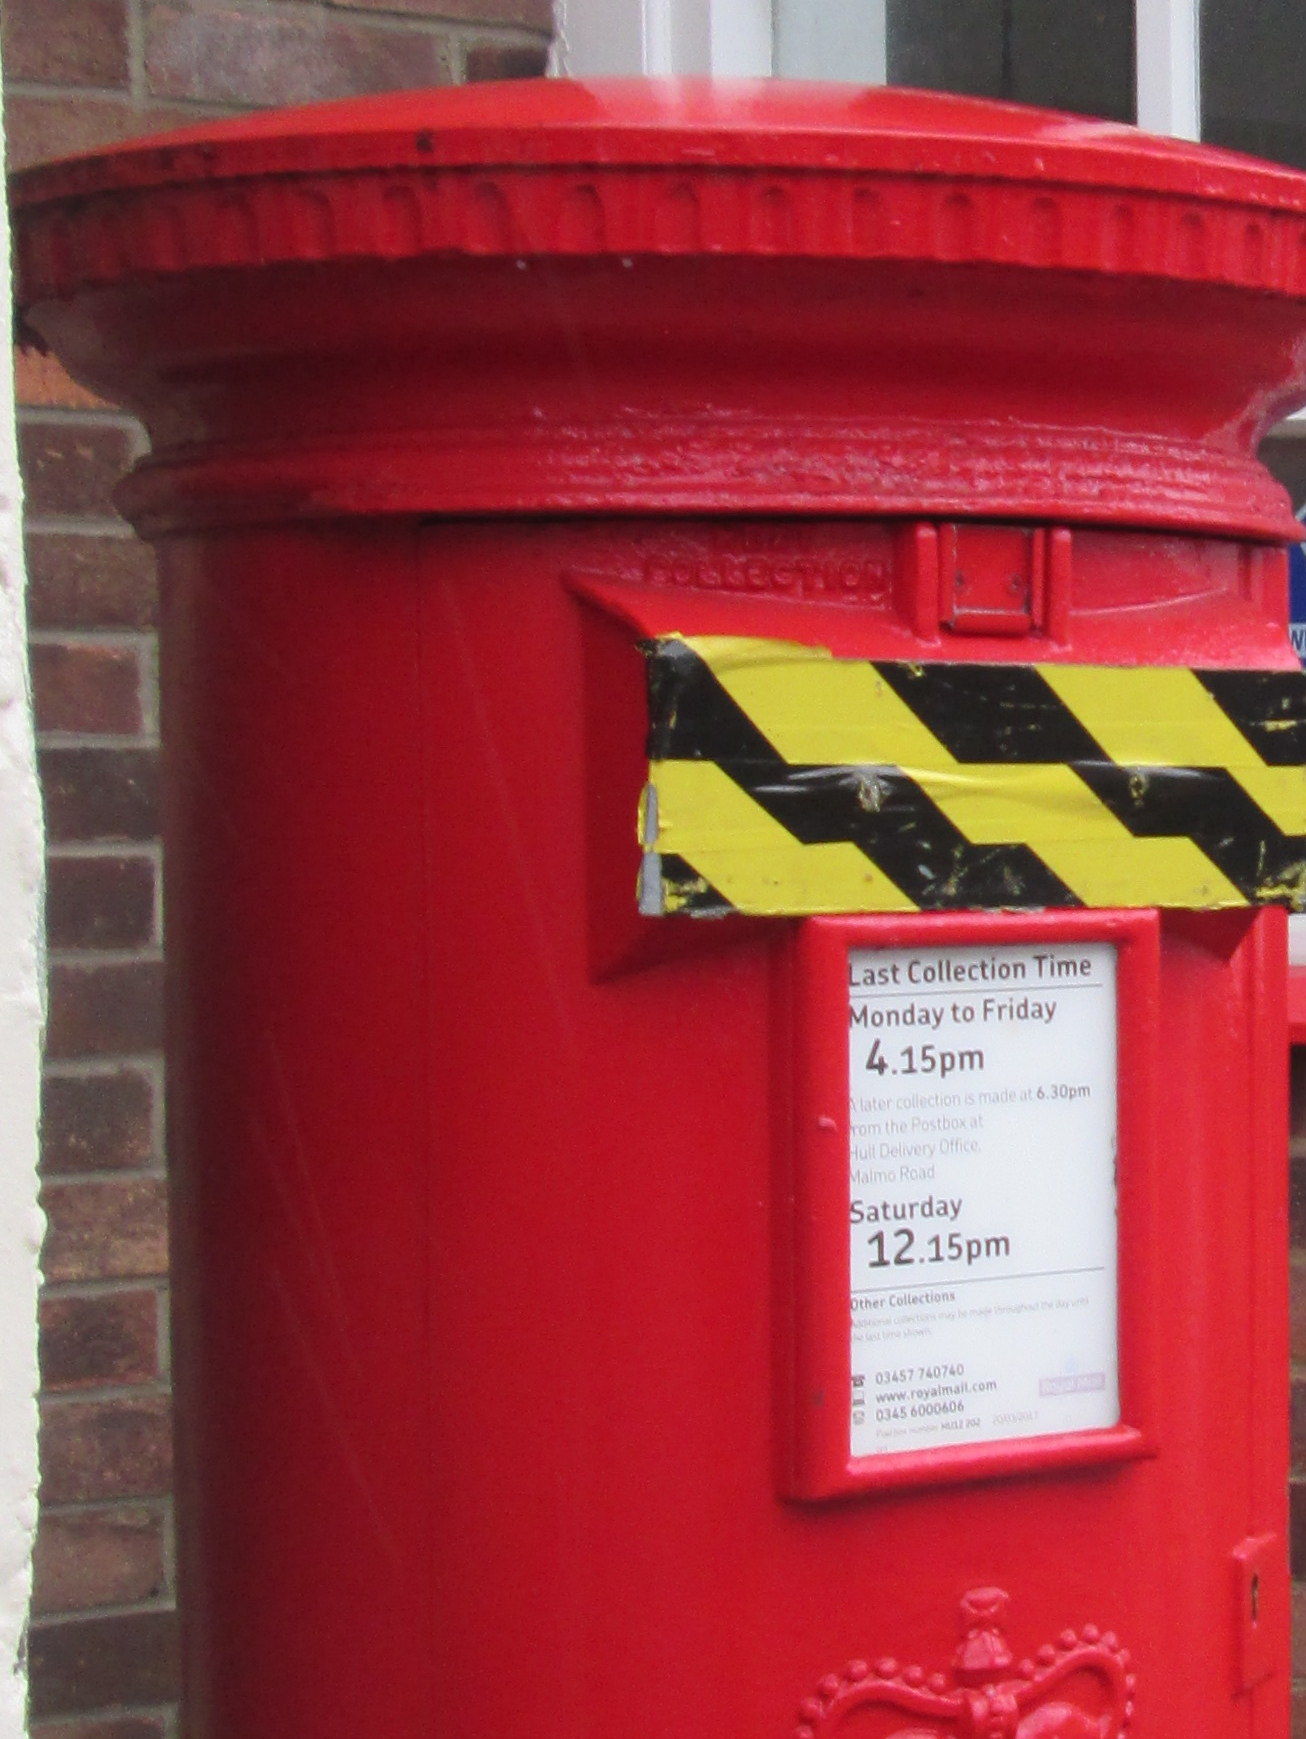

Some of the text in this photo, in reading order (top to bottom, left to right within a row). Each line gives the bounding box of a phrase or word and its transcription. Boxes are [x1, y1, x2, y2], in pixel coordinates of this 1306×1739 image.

[849, 954, 1092, 987] Last Collection Time
[849, 997, 1057, 1030] Monday to Friday
[866, 1038, 985, 1079] 4.15pm
[860, 1094, 892, 1113] later
[896, 1090, 960, 1111] collection
[965, 1091, 975, 1107] is
[978, 1087, 1016, 1105] made
[1020, 1088, 1033, 1102] at
[1036, 1084, 1091, 1102] 6.30pm
[885, 1119, 907, 1135] the
[911, 1115, 966, 1133] Postbox
[970, 1115, 984, 1129] at
[880, 1140, 936, 1159] Delivery
[900, 1163, 935, 1182] Road
[850, 1196, 962, 1224] Saturday
[868, 1228, 1010, 1268] 12.15pm
[850, 1291, 956, 1311] Other Collections
[876, 1364, 965, 1385] 03457 740740
[876, 1379, 998, 1405] www.royalmail.com
[876, 1401, 965, 1422] 0345 6000606
